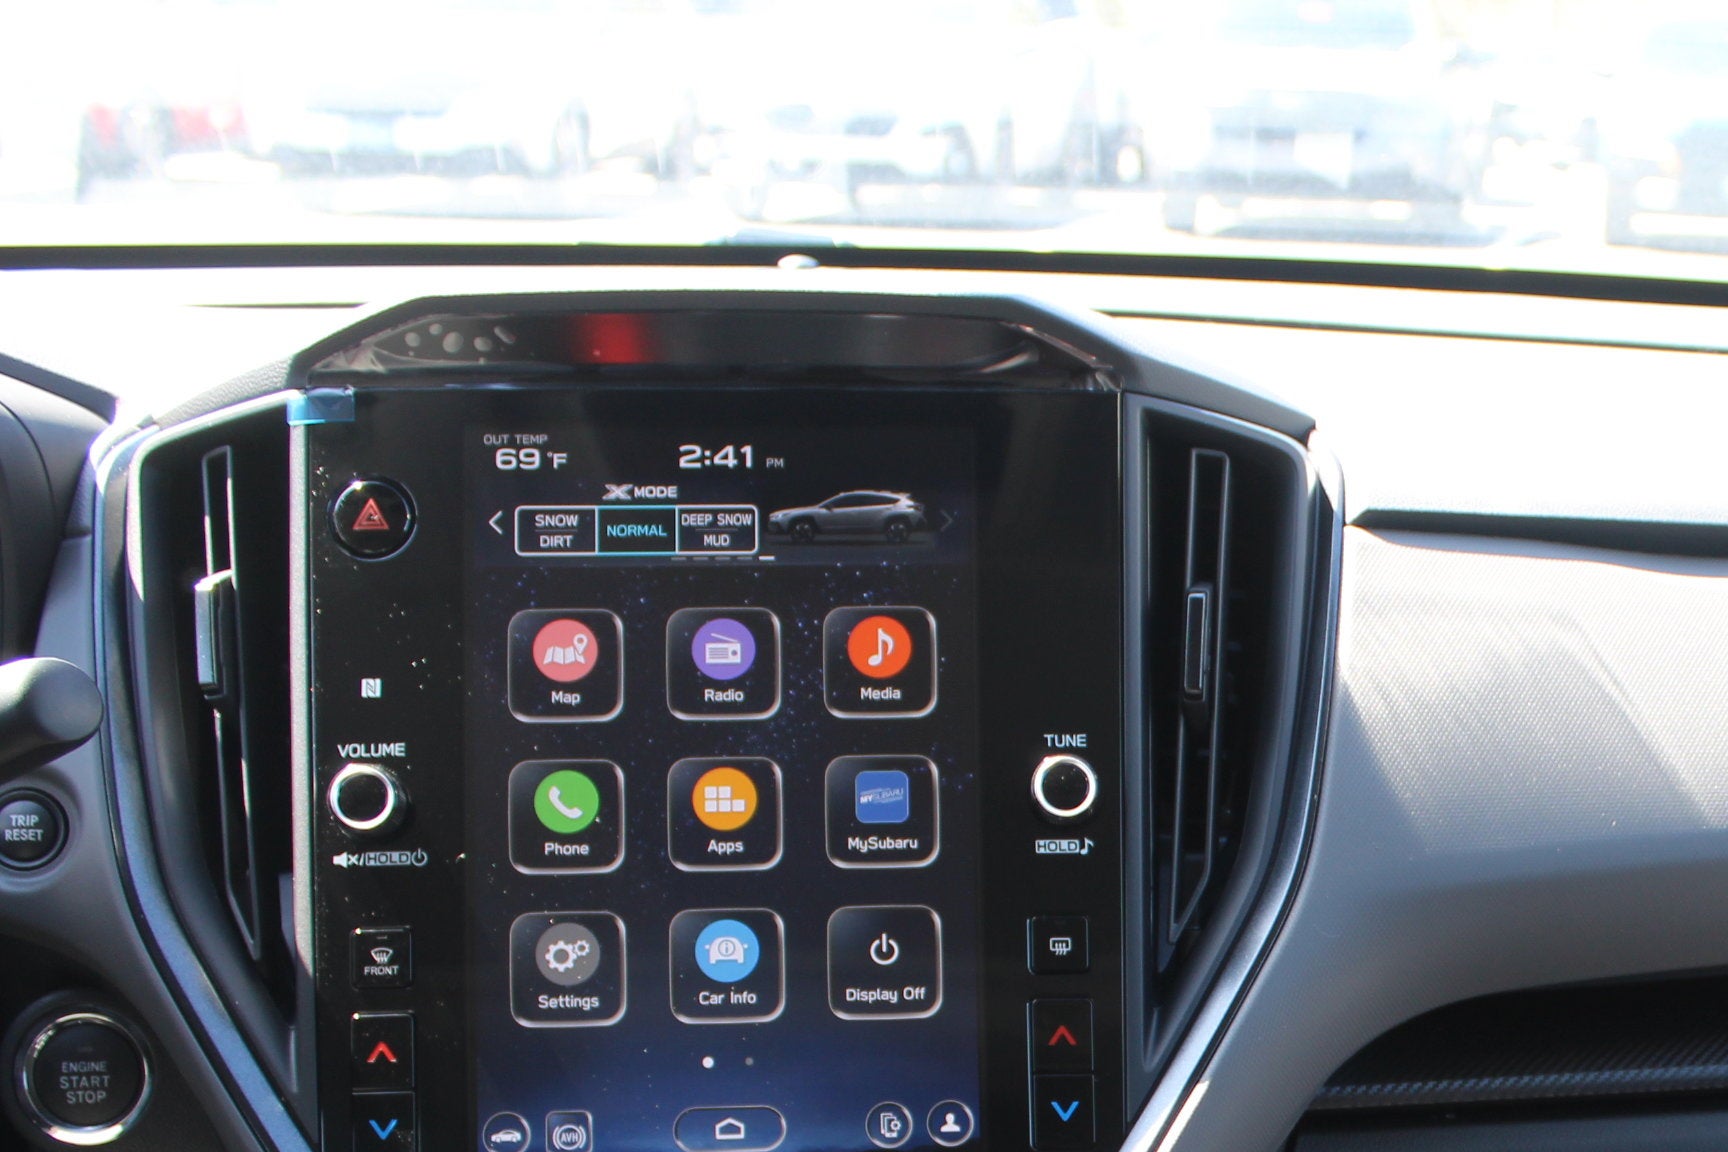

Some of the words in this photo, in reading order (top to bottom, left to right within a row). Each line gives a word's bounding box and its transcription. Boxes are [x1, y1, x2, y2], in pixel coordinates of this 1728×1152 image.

[483, 434, 509, 446] OUT
[515, 433, 549, 445] TEMP
[495, 448, 541, 470] 69
[679, 444, 754, 469] 2:41
[766, 457, 784, 469] PM
[534, 513, 579, 527] SNOW
[681, 513, 713, 527] DEEP
[717, 513, 752, 526] SNOW
[606, 523, 667, 537] NORMAL
[539, 534, 574, 548] DIRT
[703, 533, 731, 547] MUD
[551, 690, 581, 706] Map
[704, 688, 745, 702] Radio
[860, 686, 902, 701] Media
[1044, 733, 1088, 748] TUNE
[337, 743, 406, 758] VOLUME
[10, 814, 39, 827] TRIP
[4, 828, 44, 842] RESET
[544, 842, 590, 857] Phone
[707, 839, 744, 855] Apps
[847, 836, 919, 852] MySubaru
[1036, 840, 1079, 853] HOLD
[367, 852, 411, 865] HOLD
[364, 965, 399, 976] FRONT
[699, 991, 725, 1005] Car
[730, 991, 757, 1004] Info
[846, 987, 898, 1004] Display
[903, 986, 926, 1001] Off
[538, 994, 600, 1011] Settings
[61, 1061, 108, 1073] ENGINE
[59, 1075, 111, 1089] START
[66, 1090, 107, 1104] STOP
[560, 1132, 579, 1143] AVH
